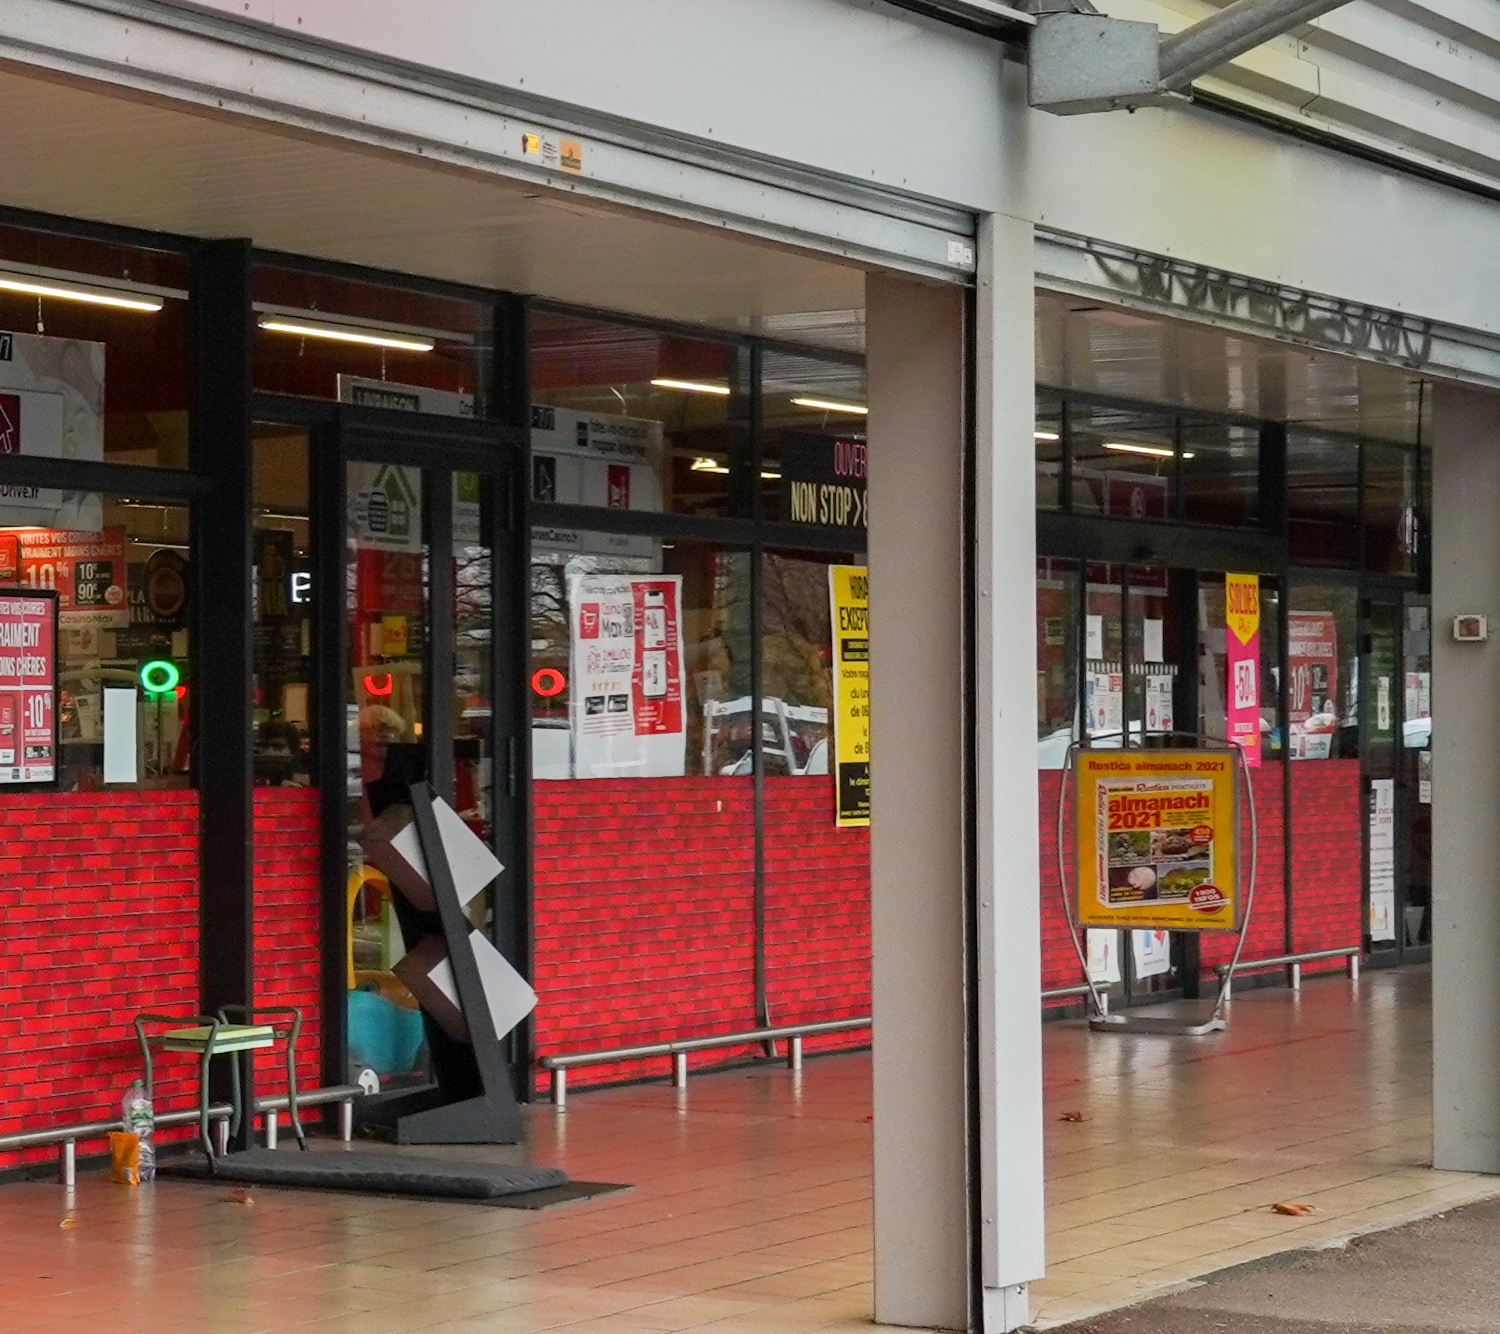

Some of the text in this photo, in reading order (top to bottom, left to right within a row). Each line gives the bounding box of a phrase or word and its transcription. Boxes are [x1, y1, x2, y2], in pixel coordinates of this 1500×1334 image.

[791, 481, 851, 526] NON STOP
[1089, 761, 1225, 771] Rustica almanach 2021
[1108, 793, 1209, 813] almanach
[1109, 811, 1161, 830] 2021
